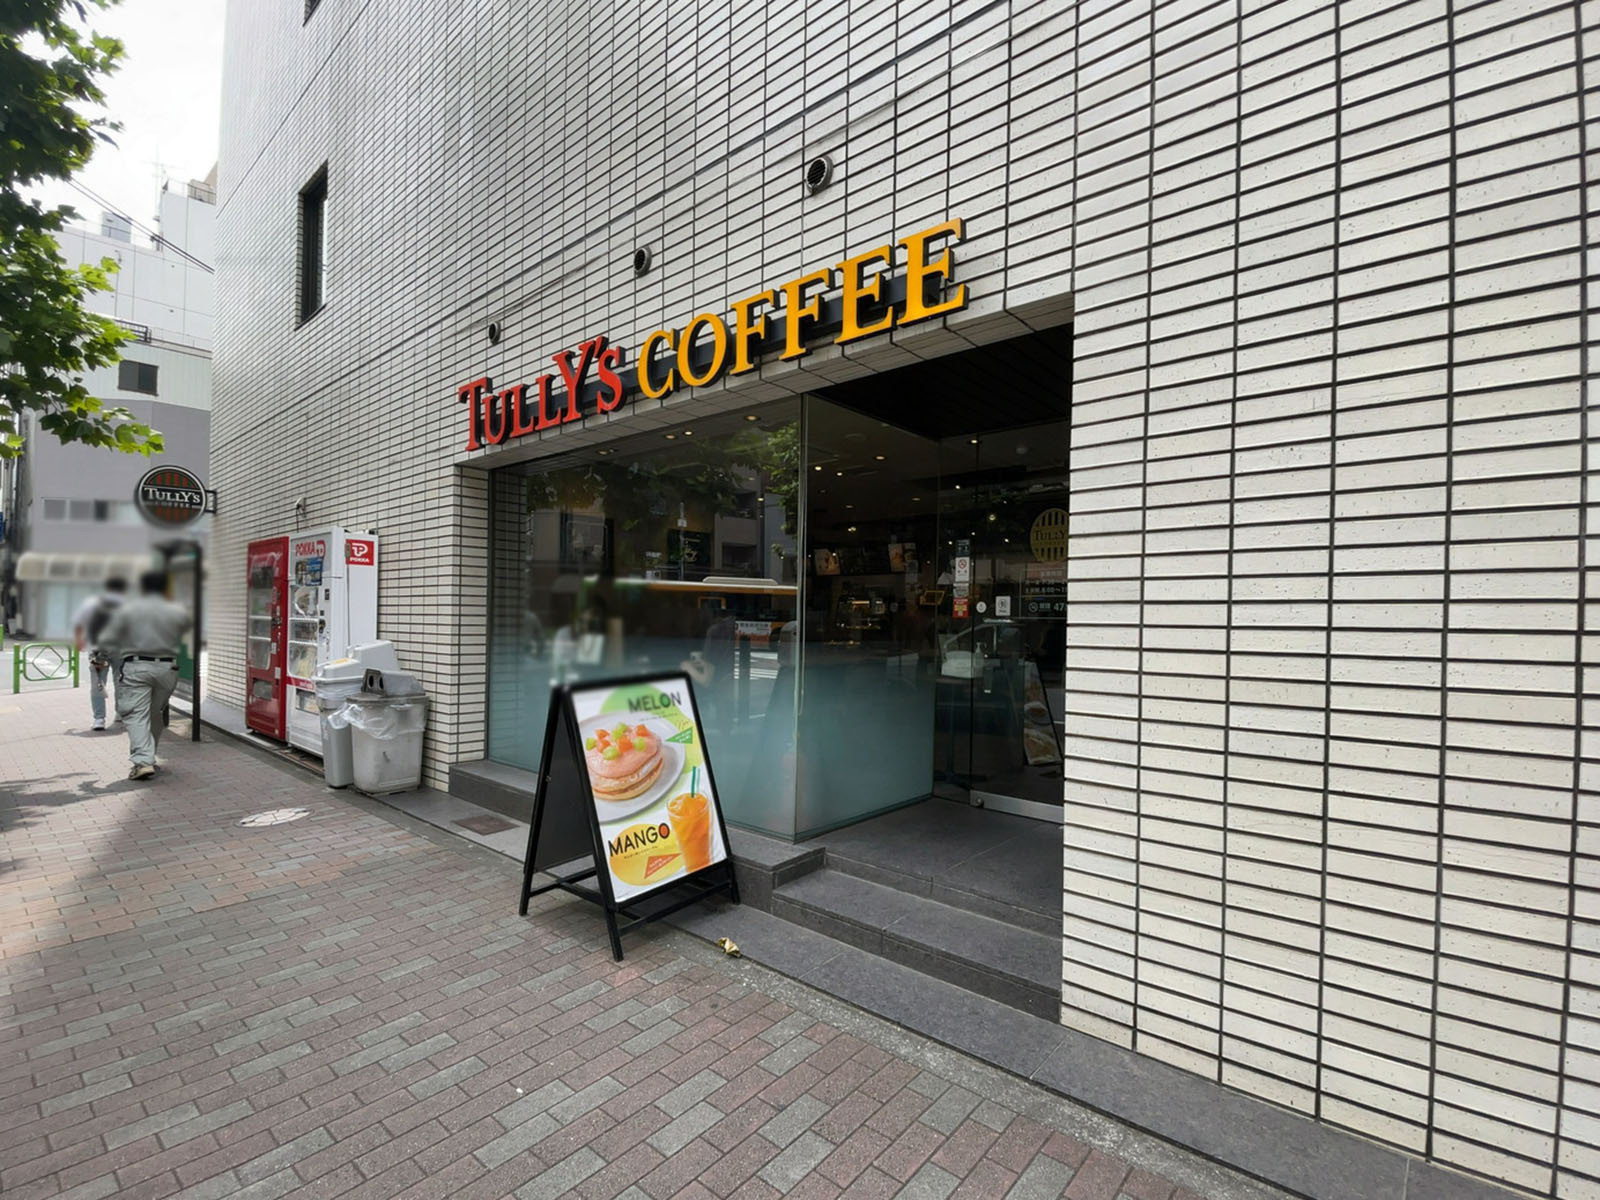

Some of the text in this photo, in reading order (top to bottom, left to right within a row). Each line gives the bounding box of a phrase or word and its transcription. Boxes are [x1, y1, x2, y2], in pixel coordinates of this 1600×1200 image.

[637, 217, 968, 399] COFFEE
[627, 691, 682, 712] MELON
[607, 822, 670, 857] MANGO
